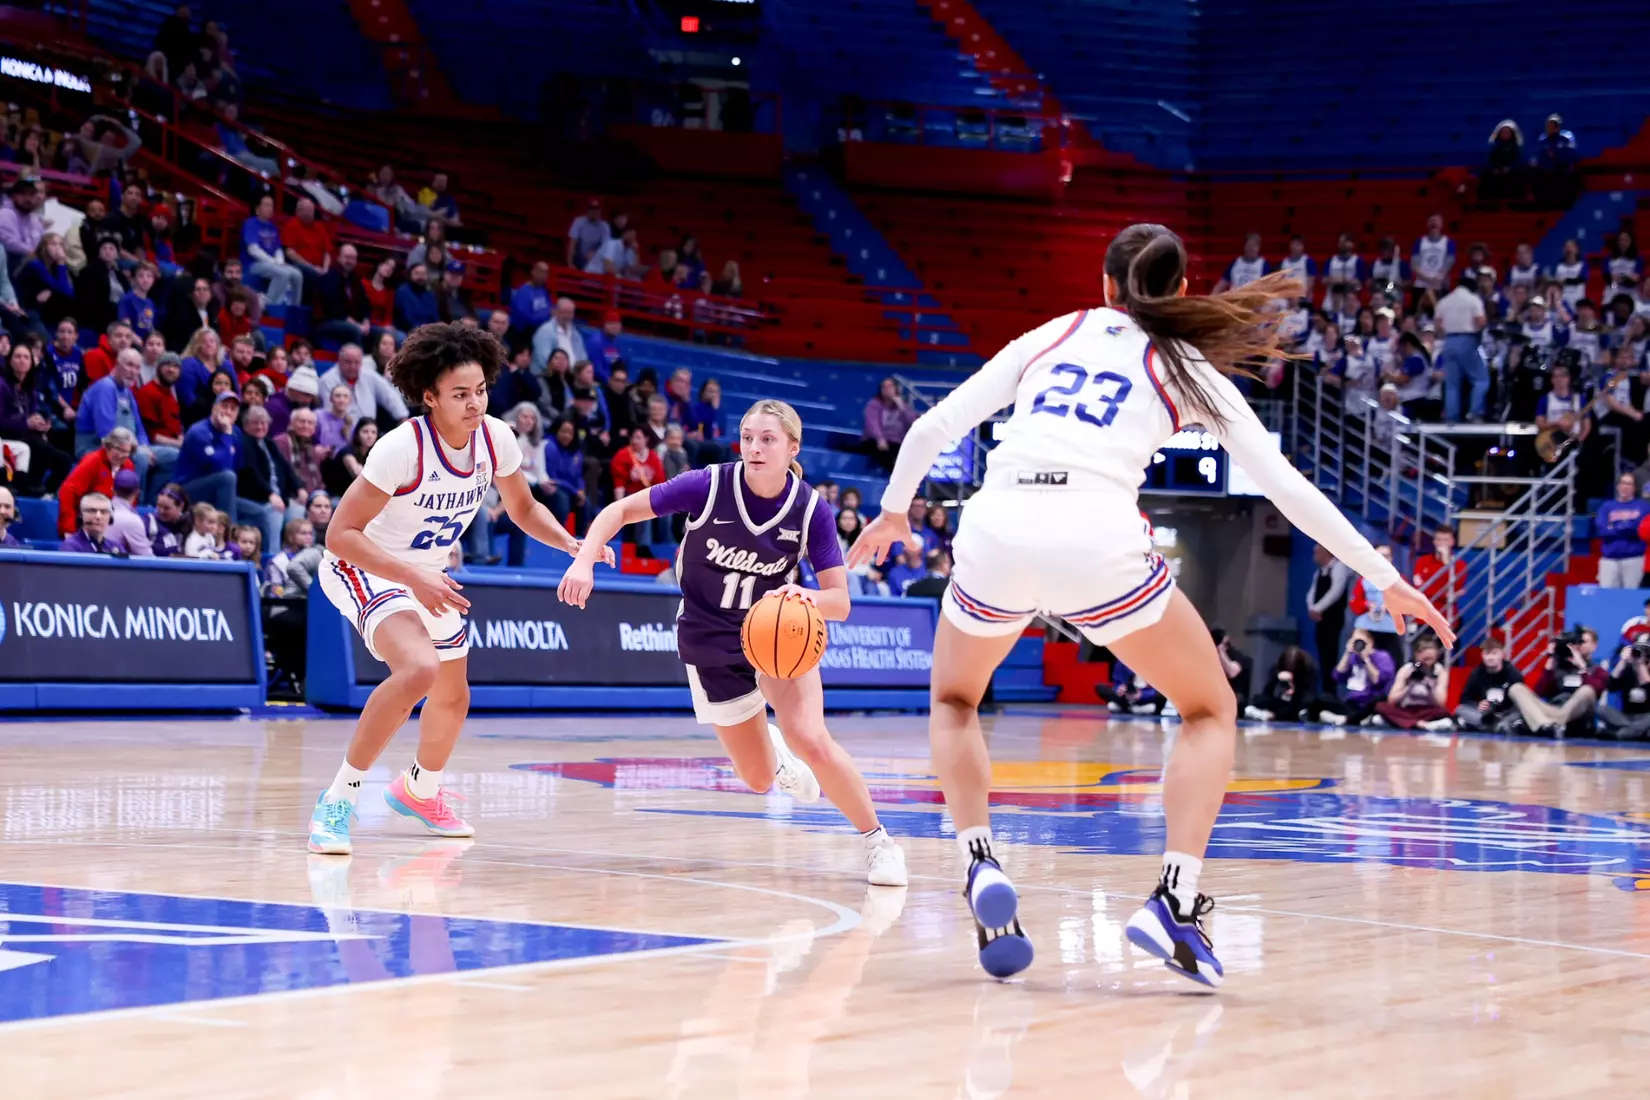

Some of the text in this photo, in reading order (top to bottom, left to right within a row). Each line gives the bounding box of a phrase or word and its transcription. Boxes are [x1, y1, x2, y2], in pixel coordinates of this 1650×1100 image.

[62, 371, 78, 389] 10
[1030, 362, 1133, 428] 23
[1198, 456, 1217, 484] 9
[409, 507, 476, 550] 25
[706, 537, 789, 577] Wildcats
[719, 571, 757, 610] 11
[13, 601, 234, 642] KONICA MINOLTA
[486, 619, 570, 651] MINOLTA
[828, 621, 896, 647] UNIVERSITY
